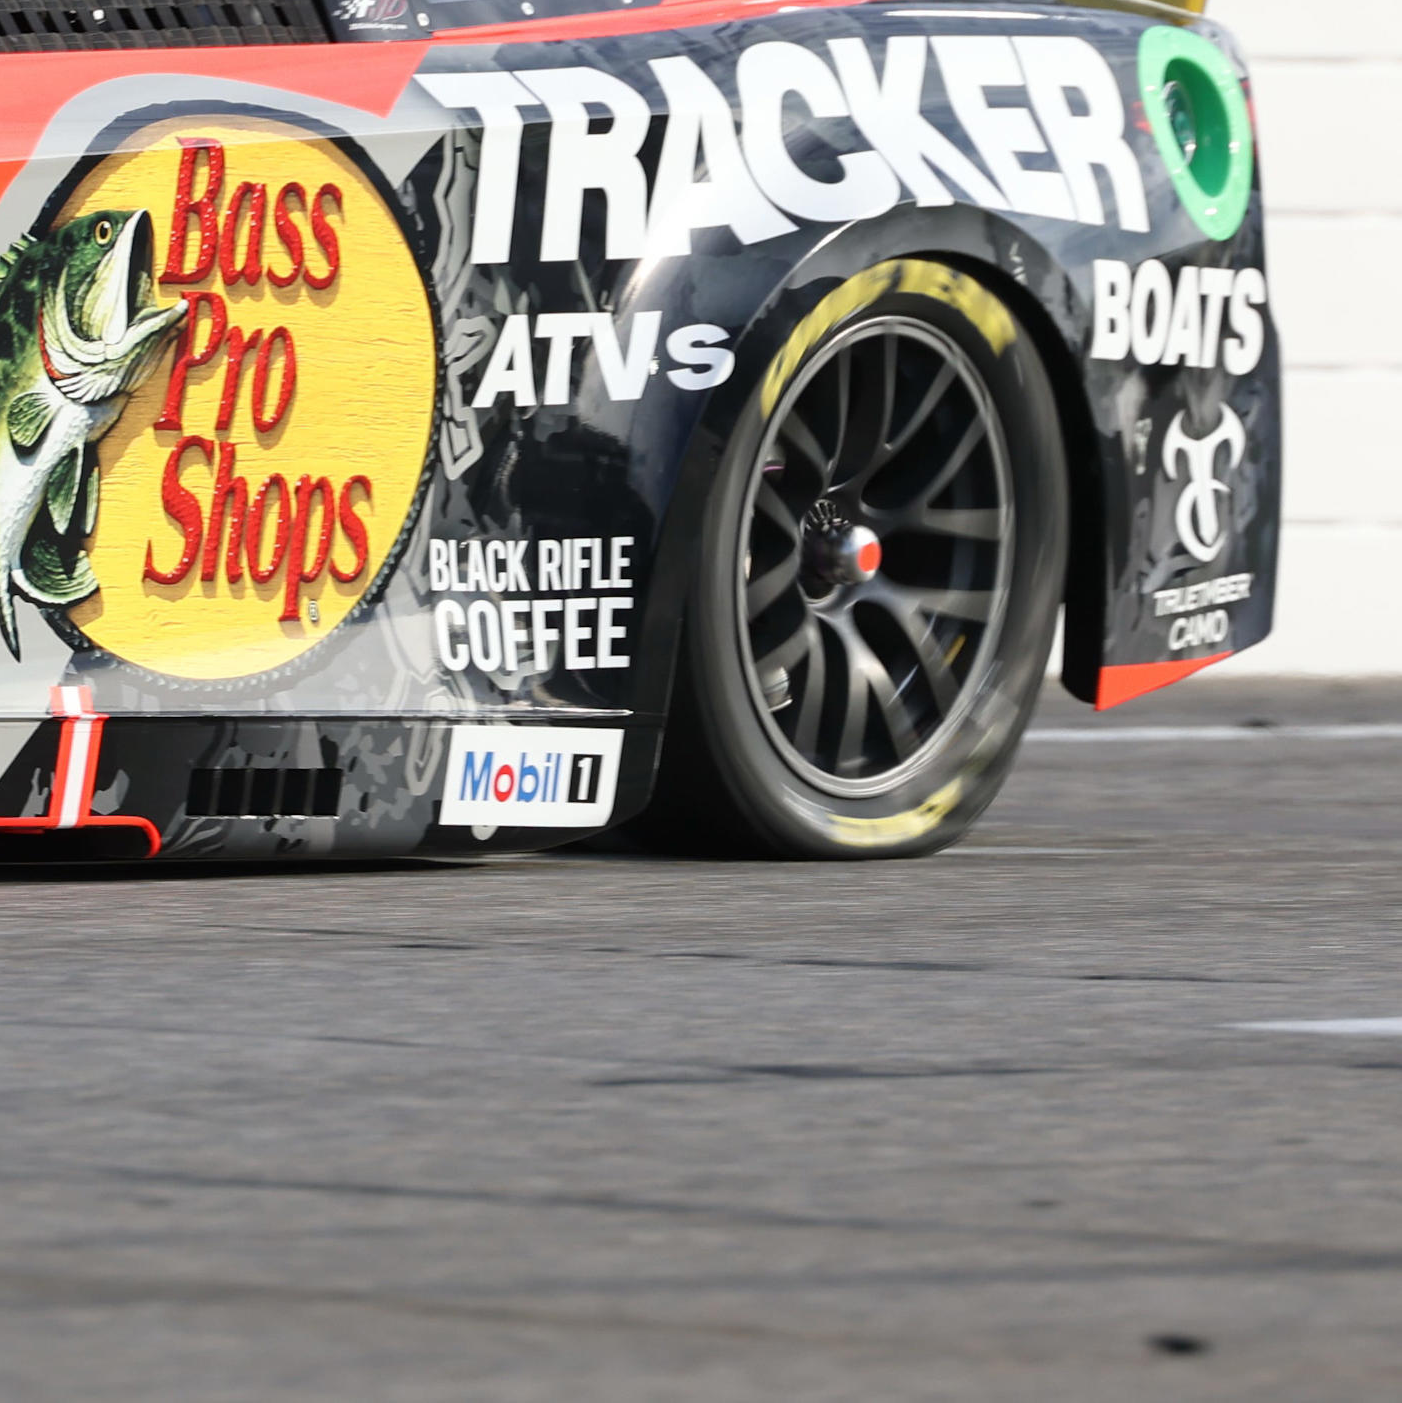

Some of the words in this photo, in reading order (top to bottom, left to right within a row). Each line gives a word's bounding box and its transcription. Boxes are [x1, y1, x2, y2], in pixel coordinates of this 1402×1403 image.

[414, 34, 1151, 265] TRACKER
[160, 136, 343, 291] Bass
[155, 292, 296, 434] Pro
[1090, 258, 1267, 376] BOATS
[144, 435, 374, 623] Shops
[430, 537, 528, 592] BLACK
[537, 535, 635, 592] RIFLE
[435, 596, 634, 673] COFFEE
[1168, 609, 1229, 651] CAMO
[459, 749, 561, 804] Mobil
